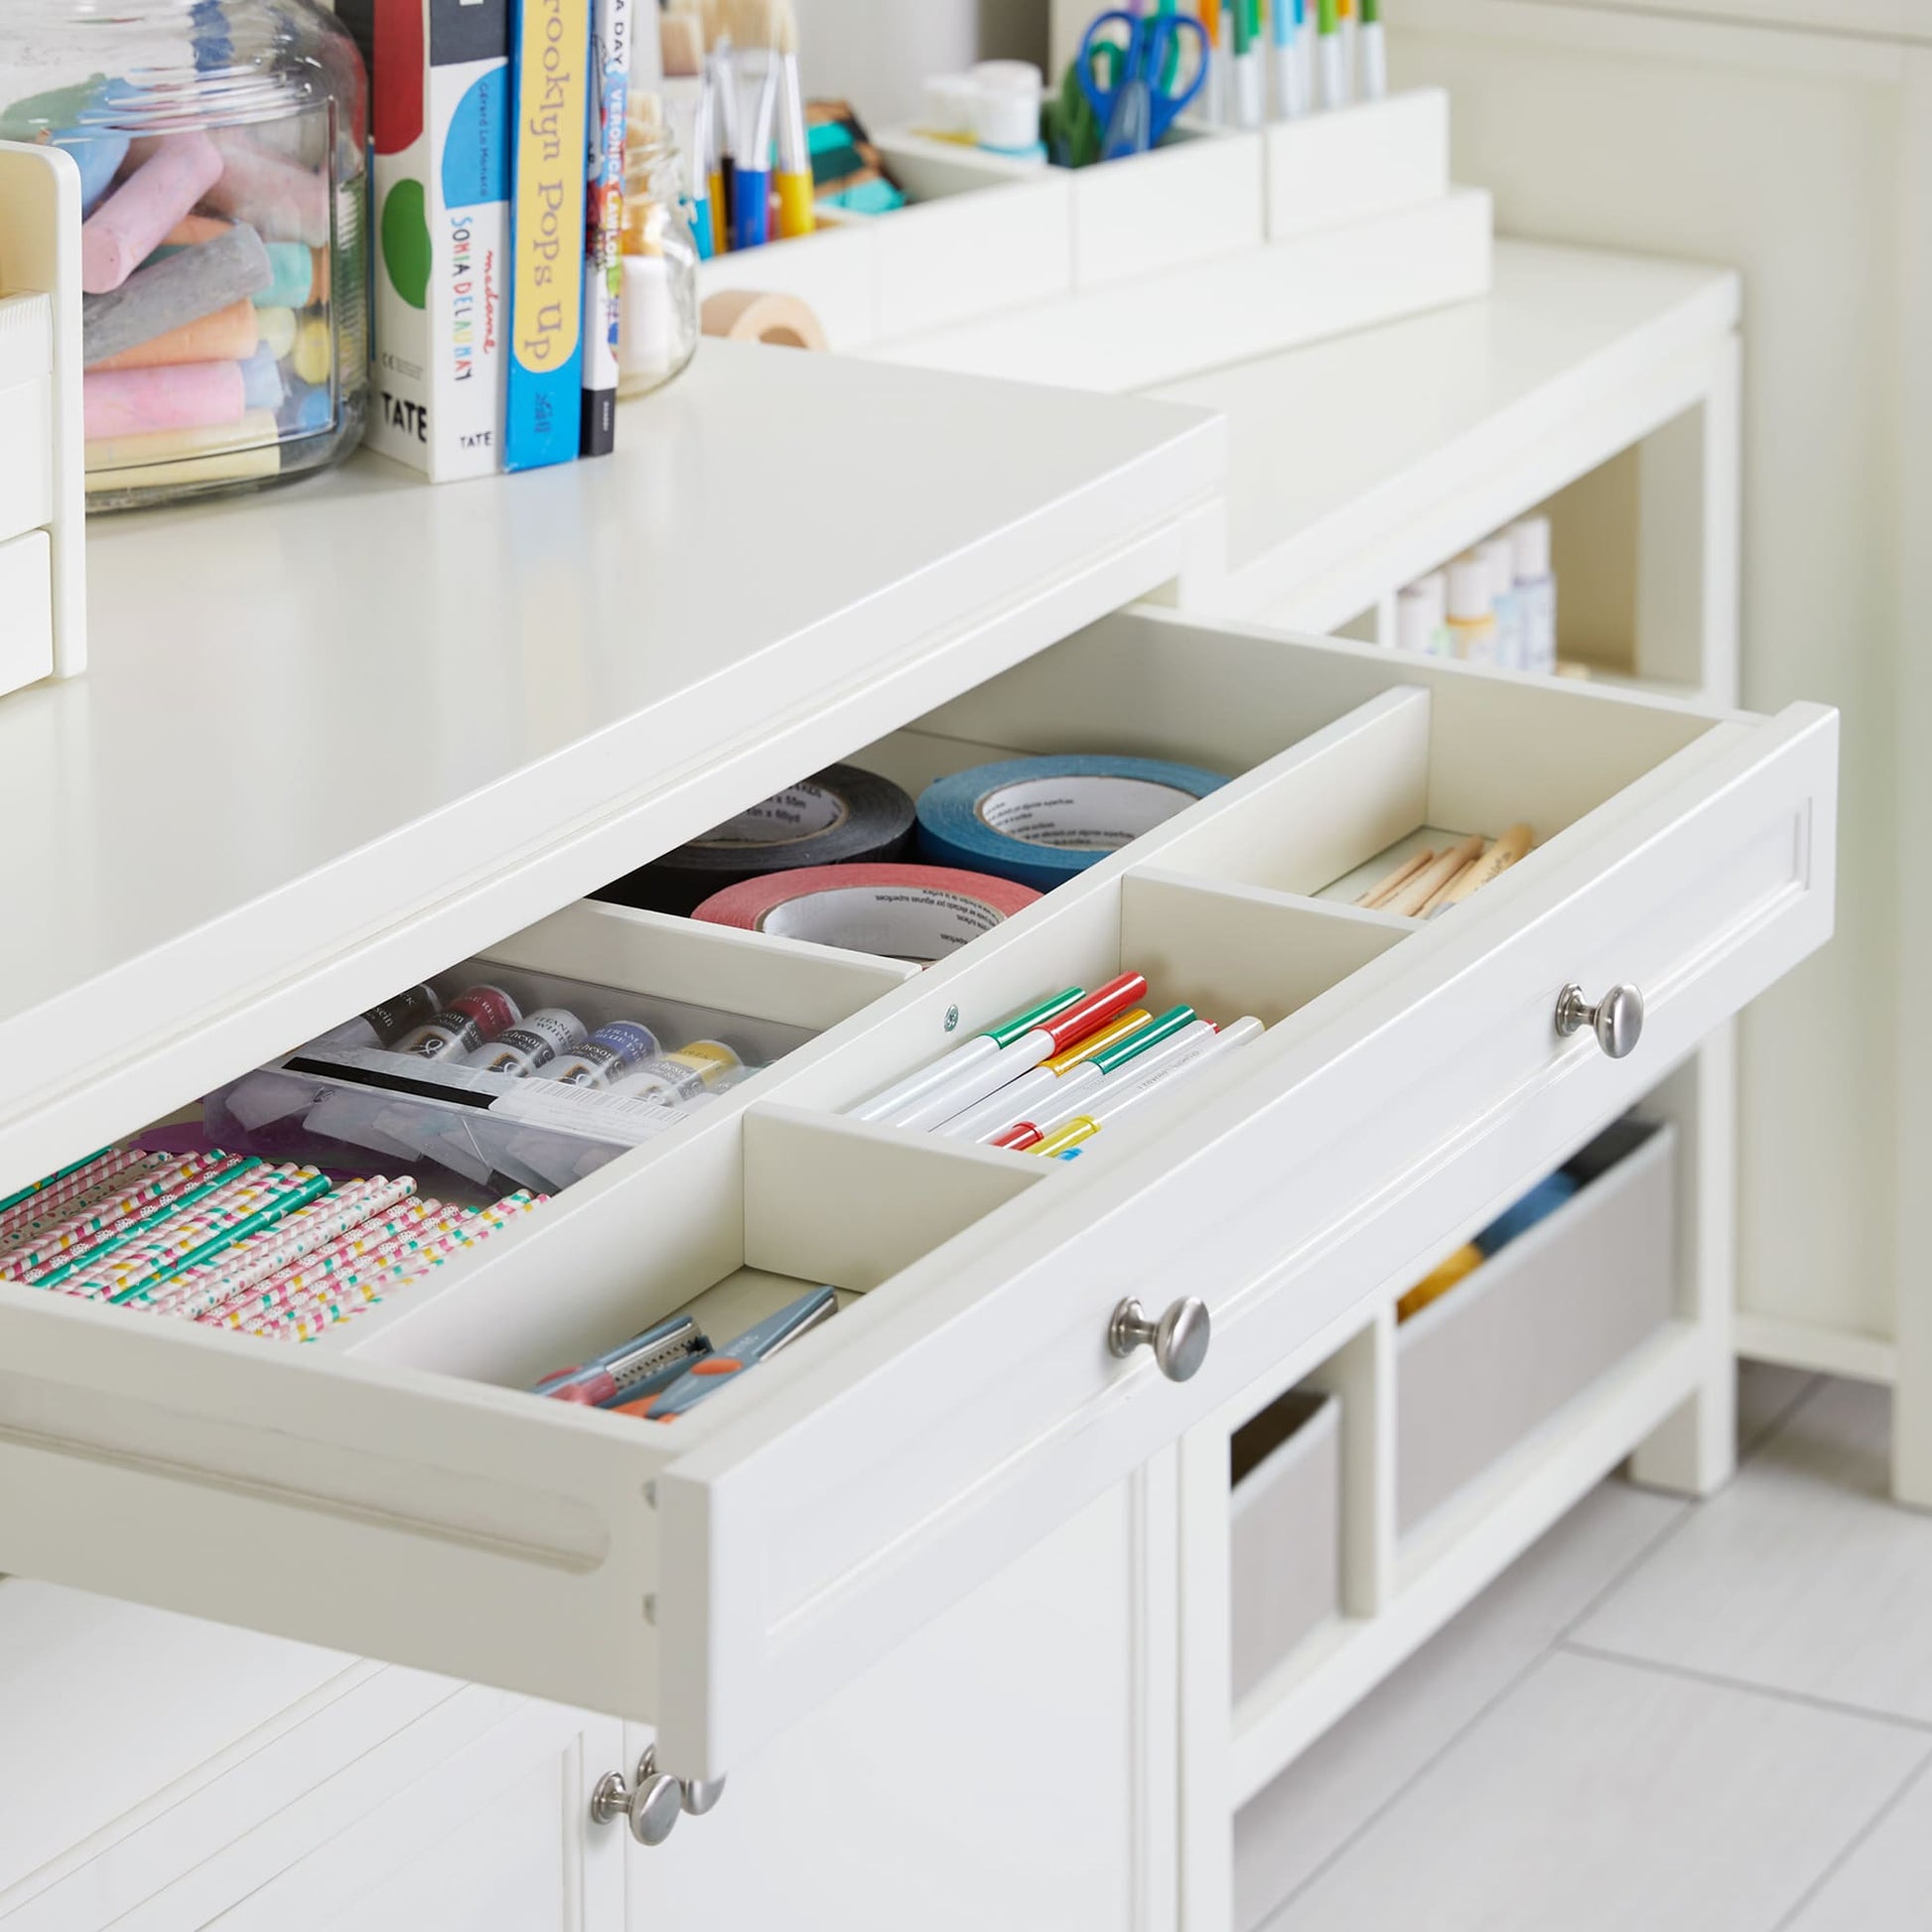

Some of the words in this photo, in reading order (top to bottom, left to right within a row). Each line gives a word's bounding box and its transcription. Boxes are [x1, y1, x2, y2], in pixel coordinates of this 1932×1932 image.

[614, 22, 624, 65] DAY
[529, 0, 571, 162] rooklyn
[608, 88, 623, 186] VERONICA
[452, 215, 474, 277] SONIA
[532, 180, 564, 288] Pops
[453, 282, 474, 382] DELAUNAY
[523, 301, 563, 361] Up
[380, 390, 428, 444] TATE
[460, 431, 493, 450] TATE
[375, 1007, 394, 1029] sein
